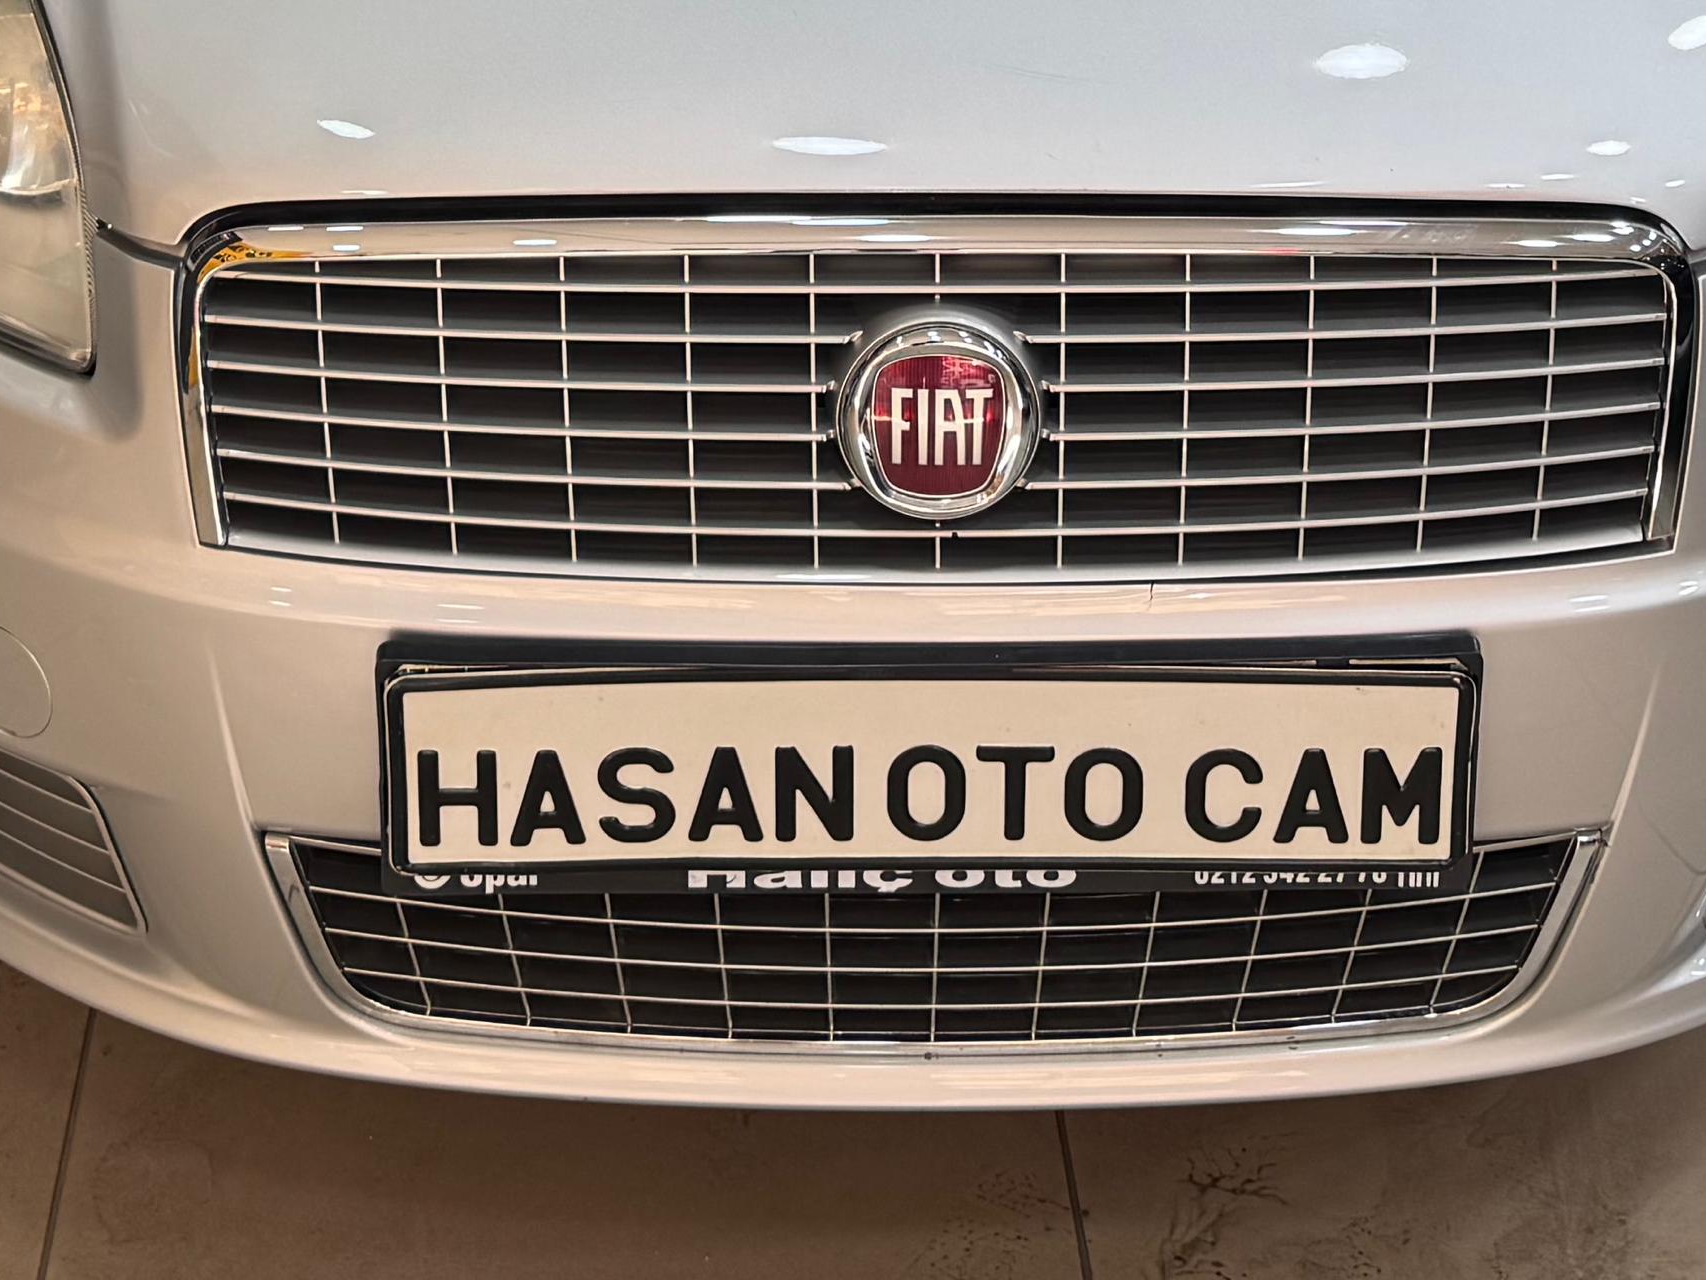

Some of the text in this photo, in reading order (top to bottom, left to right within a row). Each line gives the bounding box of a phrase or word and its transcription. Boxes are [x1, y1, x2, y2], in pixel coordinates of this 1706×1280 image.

[890, 386, 995, 466] FIAT
[417, 743, 1444, 847] HASAN OTO CAM
